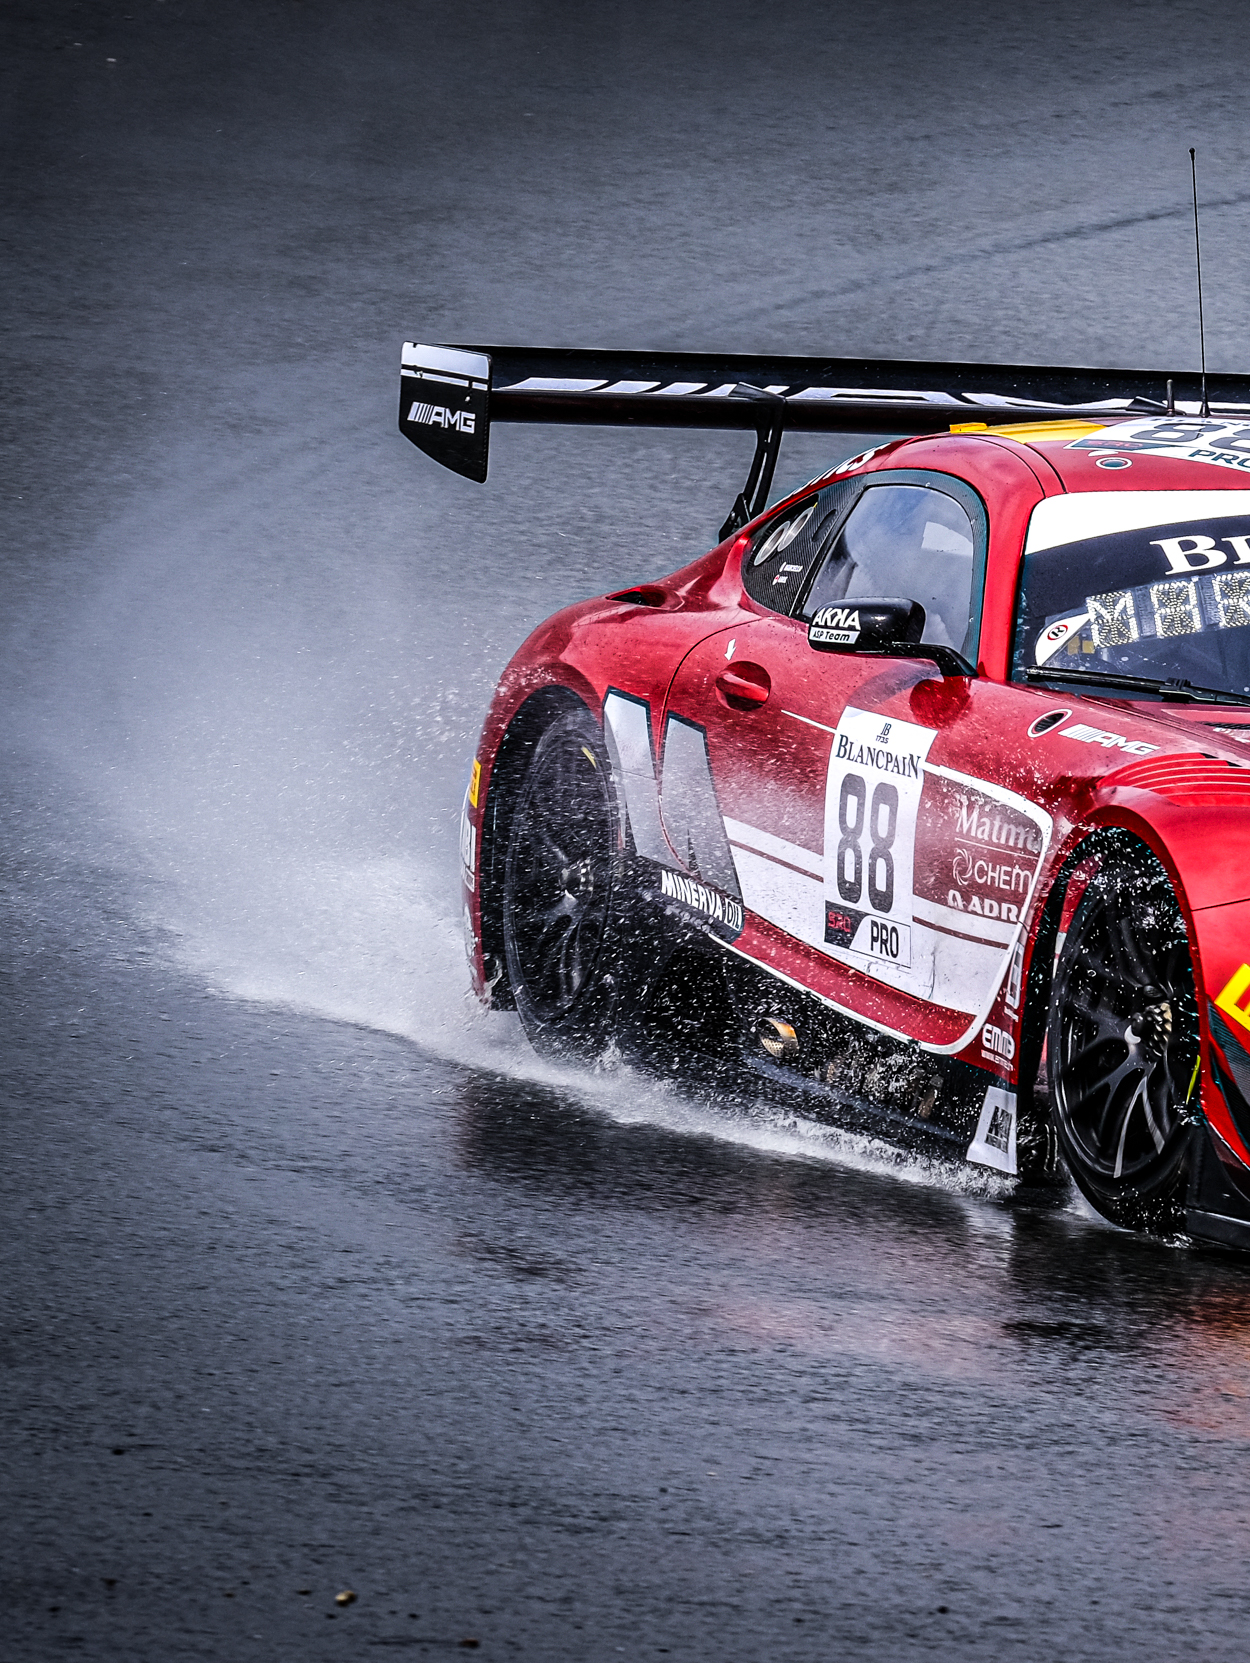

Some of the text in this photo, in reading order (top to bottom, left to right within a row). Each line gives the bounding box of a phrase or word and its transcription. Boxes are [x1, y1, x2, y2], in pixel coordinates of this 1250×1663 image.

[428, 406, 476, 434] AMG
[812, 607, 862, 631] AKKA
[825, 632, 851, 641] Team
[835, 733, 921, 779] BLANCPAIN
[1097, 731, 1161, 756] AMG
[837, 772, 899, 914] 88
[661, 869, 723, 922] MINERVA
[870, 919, 899, 959] PRO
